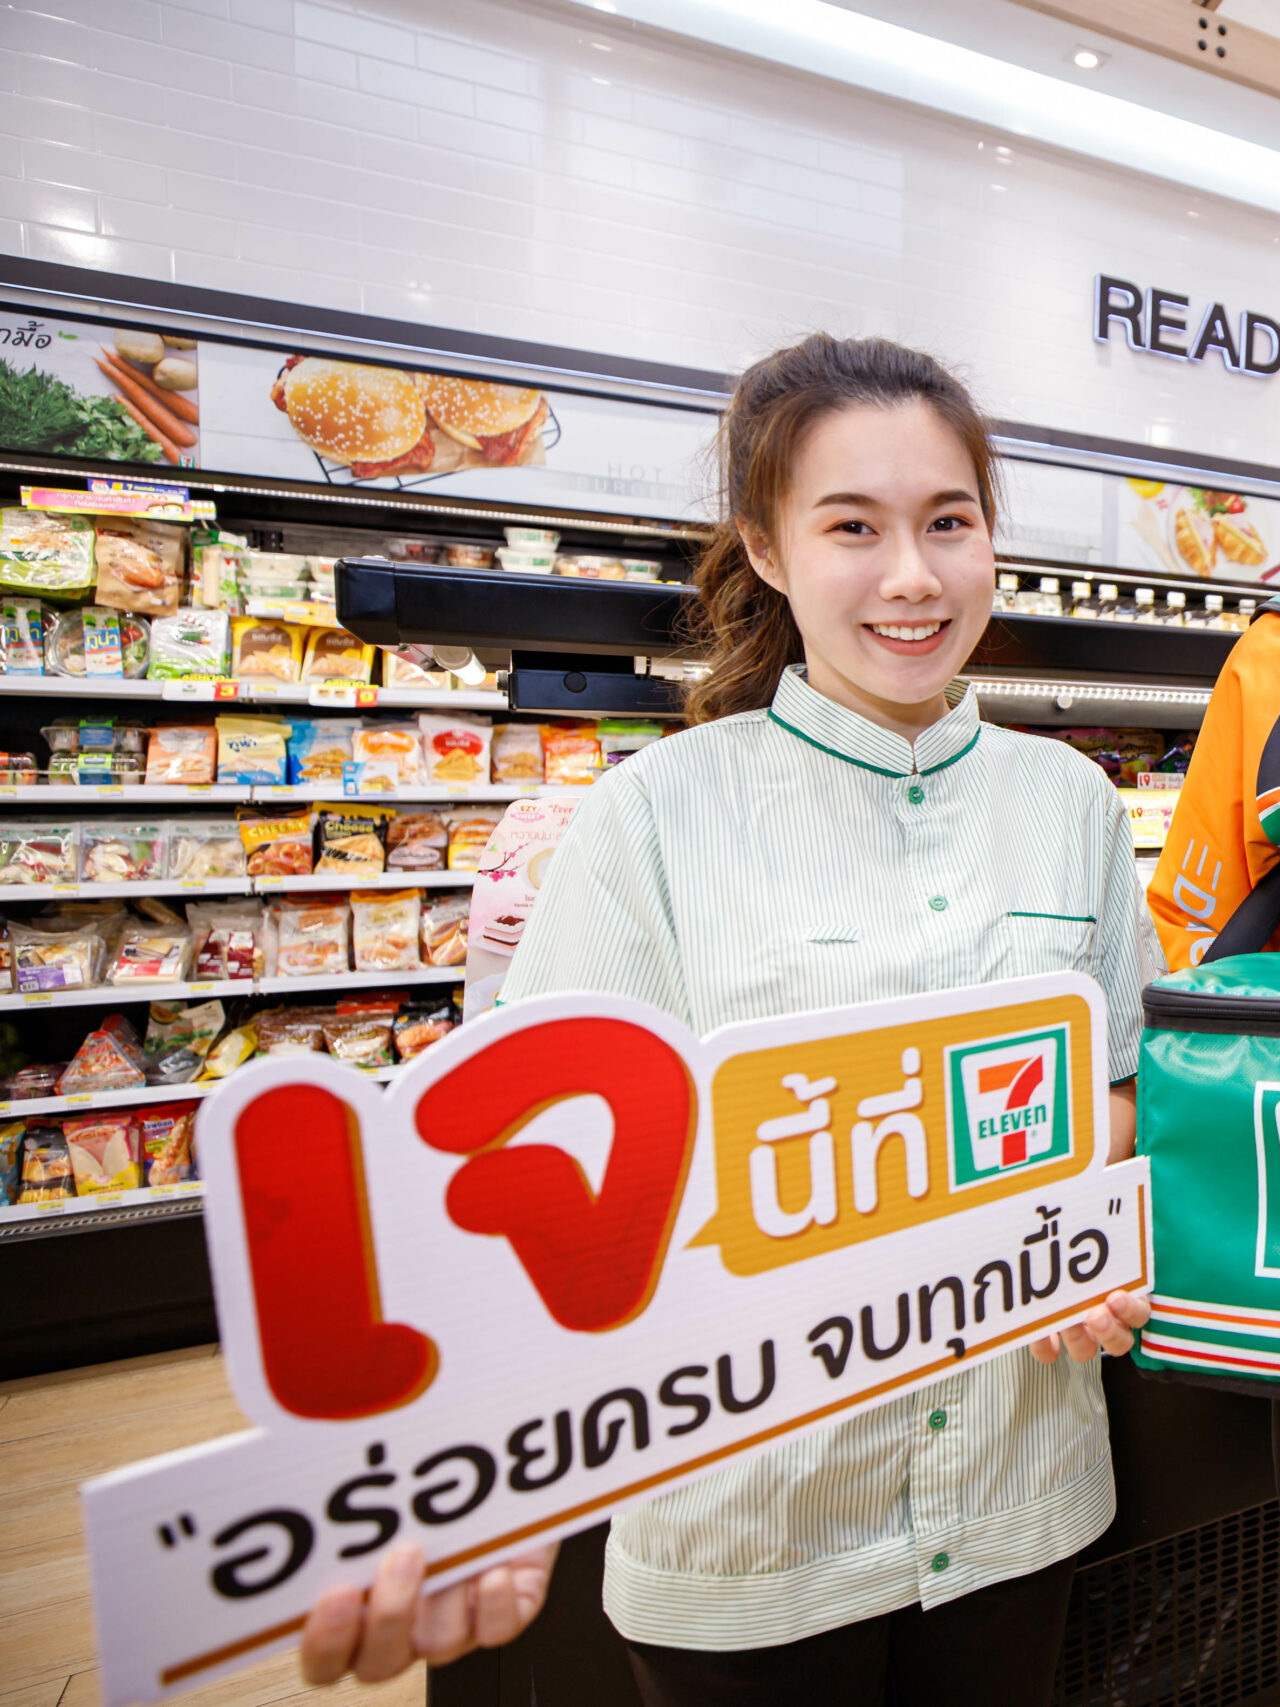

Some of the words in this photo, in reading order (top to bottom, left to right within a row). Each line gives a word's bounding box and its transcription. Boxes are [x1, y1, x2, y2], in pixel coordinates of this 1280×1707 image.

[520, 805, 537, 813] EZY
[976, 1106, 1048, 1142] ELEVEN
[977, 1053, 1045, 1168] 7
[235, 1015, 700, 1417] เจ
[748, 1046, 932, 1240] นี้ที่
